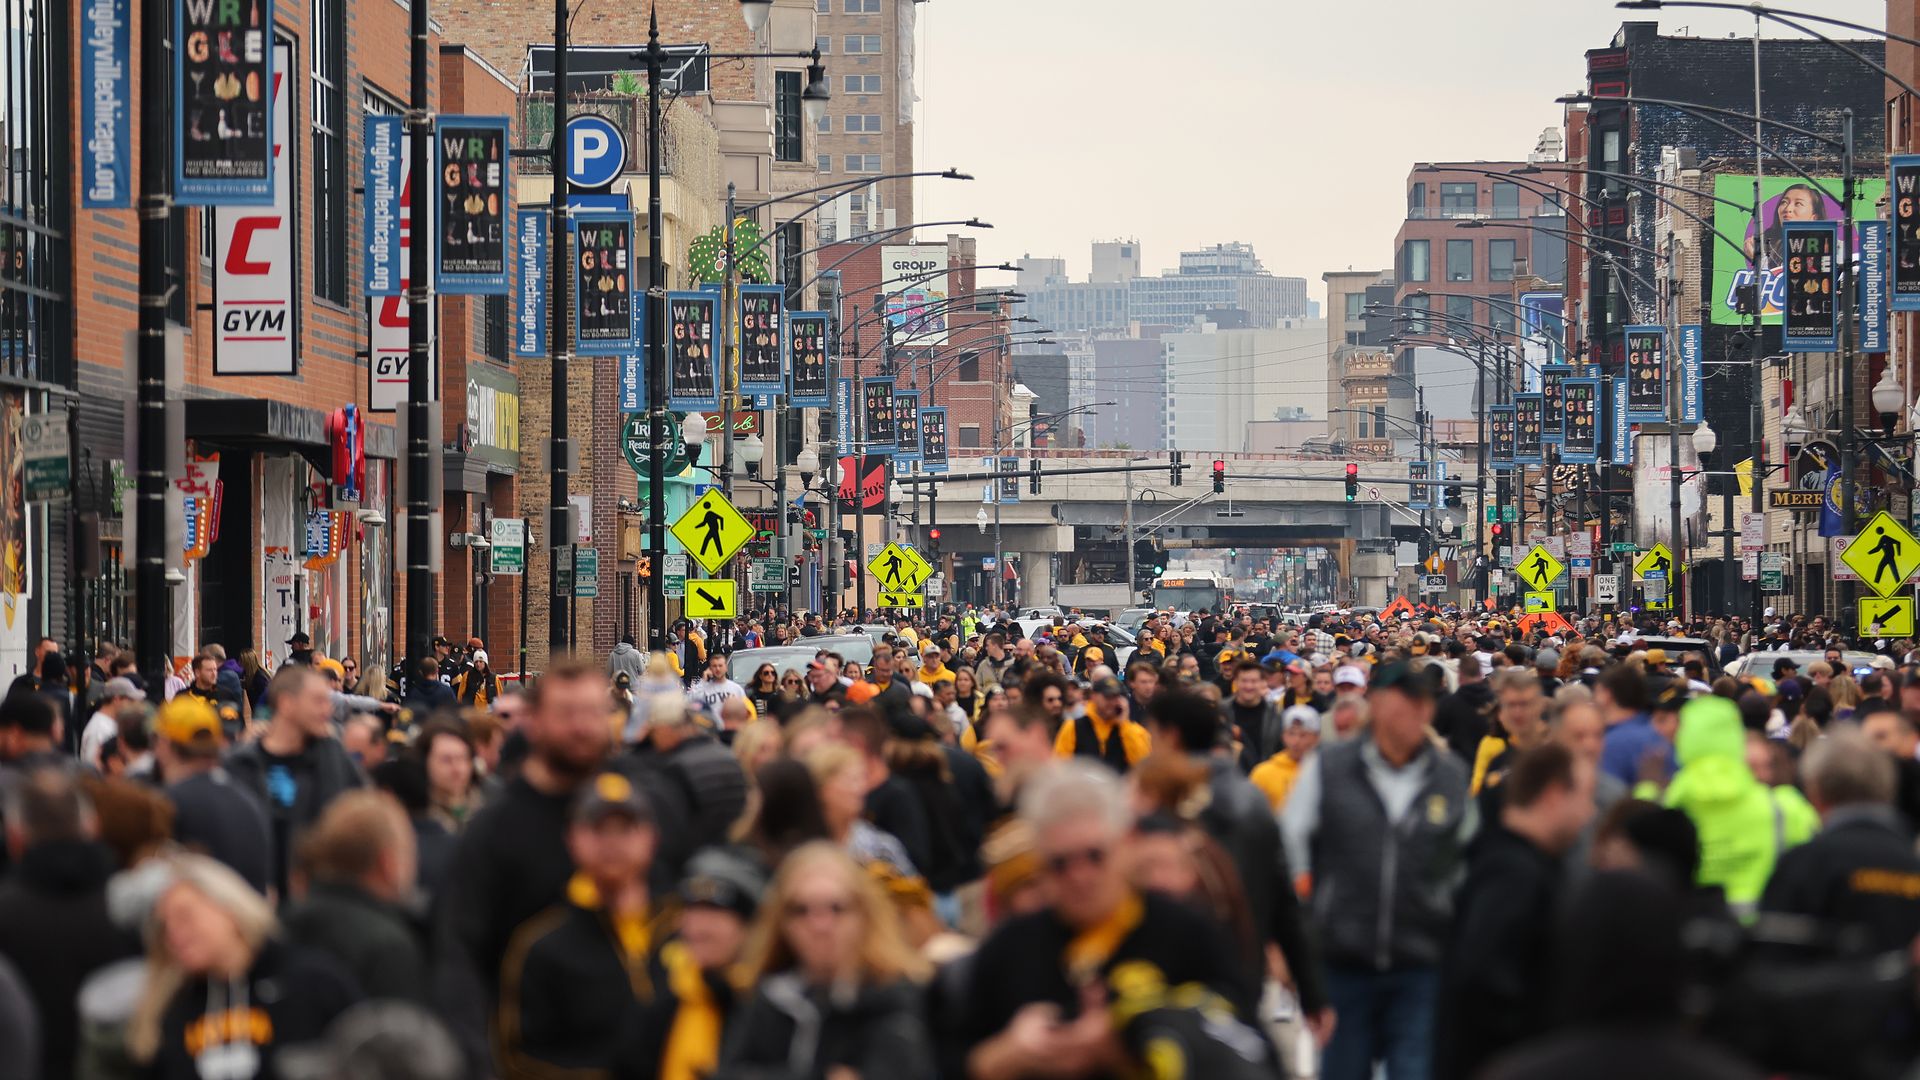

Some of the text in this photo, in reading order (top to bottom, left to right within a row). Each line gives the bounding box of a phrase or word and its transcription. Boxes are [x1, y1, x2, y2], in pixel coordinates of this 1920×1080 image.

[88, 0, 122, 201] igleyvillechicago.org
[573, 129, 609, 175] P
[370, 122, 396, 290] wrigleyvillechicago.org
[225, 216, 282, 275] C
[892, 261, 937, 270] GROUP
[521, 216, 542, 352] wrigleyvillechicago.org
[1863, 225, 1883, 348] wrigleyvillechicago.org
[223, 310, 286, 332] GYM
[377, 356, 409, 375] GY
[1683, 329, 1698, 421] wrigleyvillechicago.org
[628, 440, 674, 454] Restant
[1774, 491, 1824, 507] MERK
[1599, 576, 1616, 584] ONE
[705, 691, 732, 705] IOW
